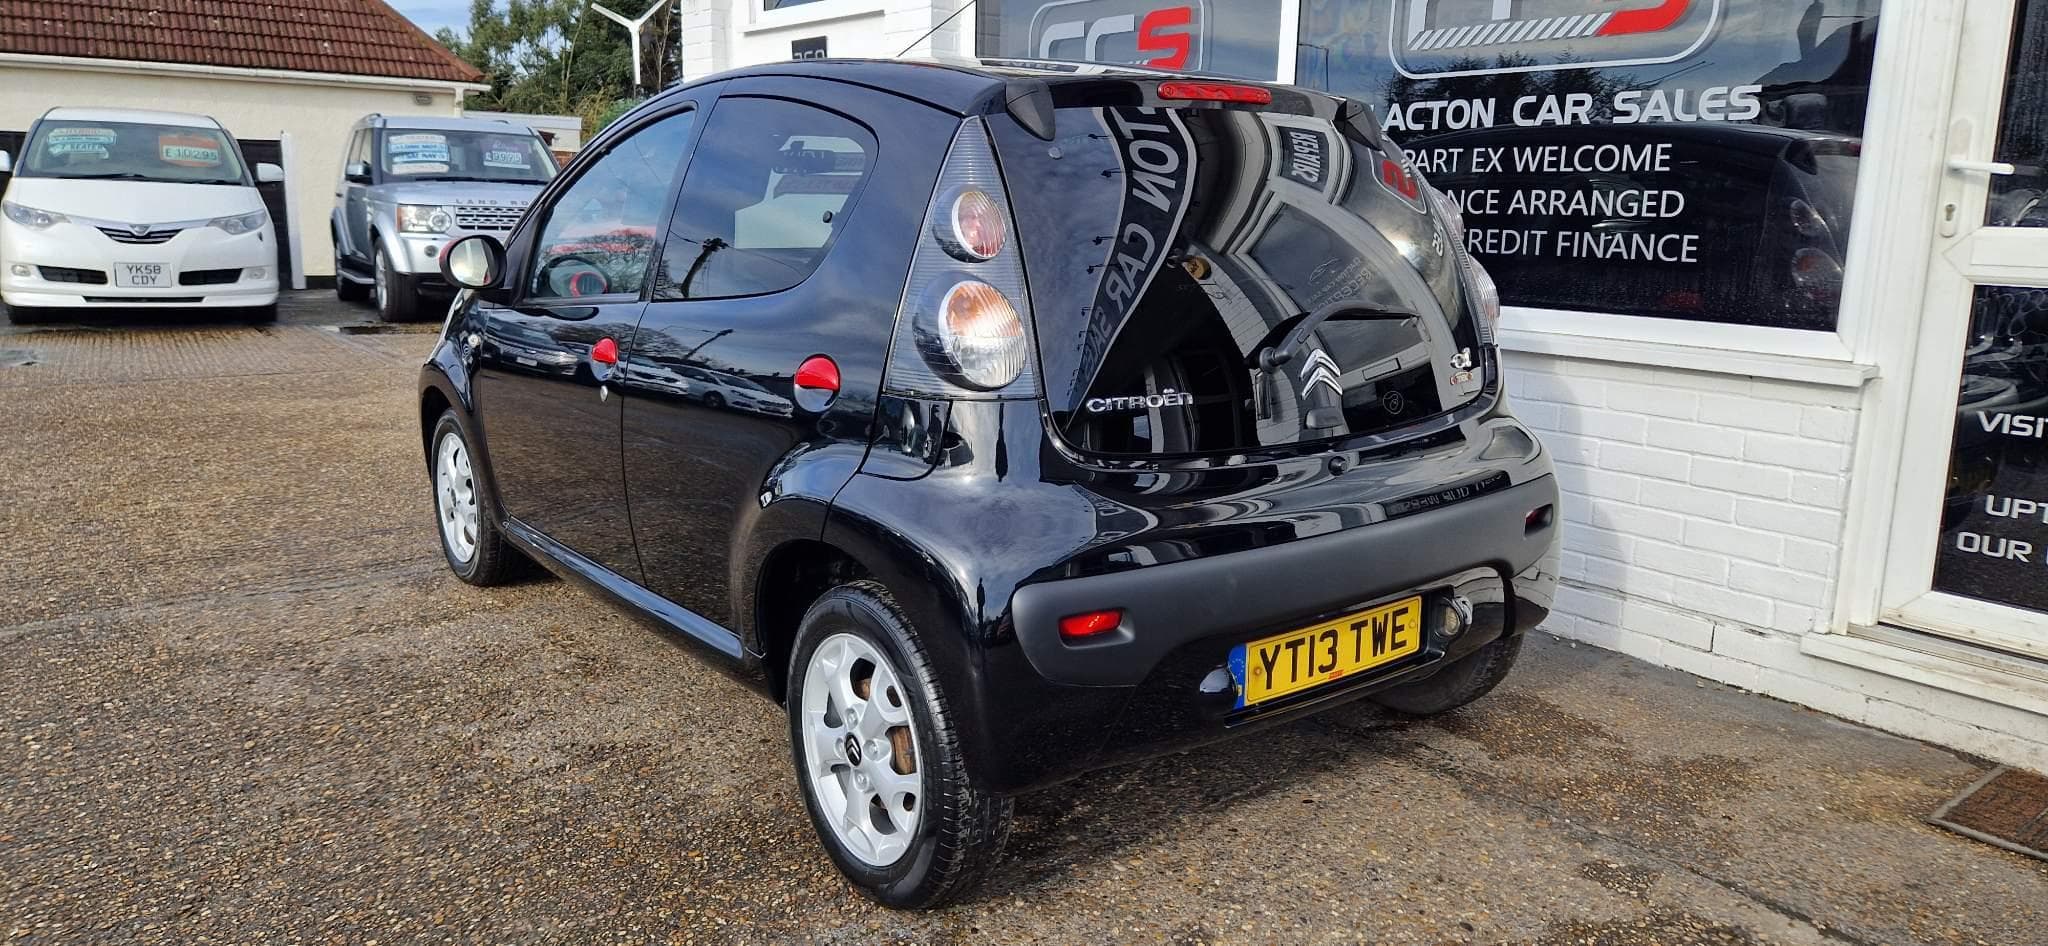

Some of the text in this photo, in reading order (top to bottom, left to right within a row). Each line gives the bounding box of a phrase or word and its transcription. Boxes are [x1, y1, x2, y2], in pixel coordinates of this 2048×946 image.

[1382, 85, 1763, 131] ACTON CAR SALES
[1471, 148, 1503, 173] EX
[1512, 143, 1673, 173] WELCOME
[1447, 189, 1686, 218] NCE ARRANGED
[1464, 228, 1552, 256] REDIT
[1556, 231, 1699, 263] FINANCE
[132, 275, 157, 285] CDY
[1977, 411, 2048, 438] VISI
[1956, 531, 2033, 563] OUR
[1260, 607, 1409, 690] YT13 TWE
